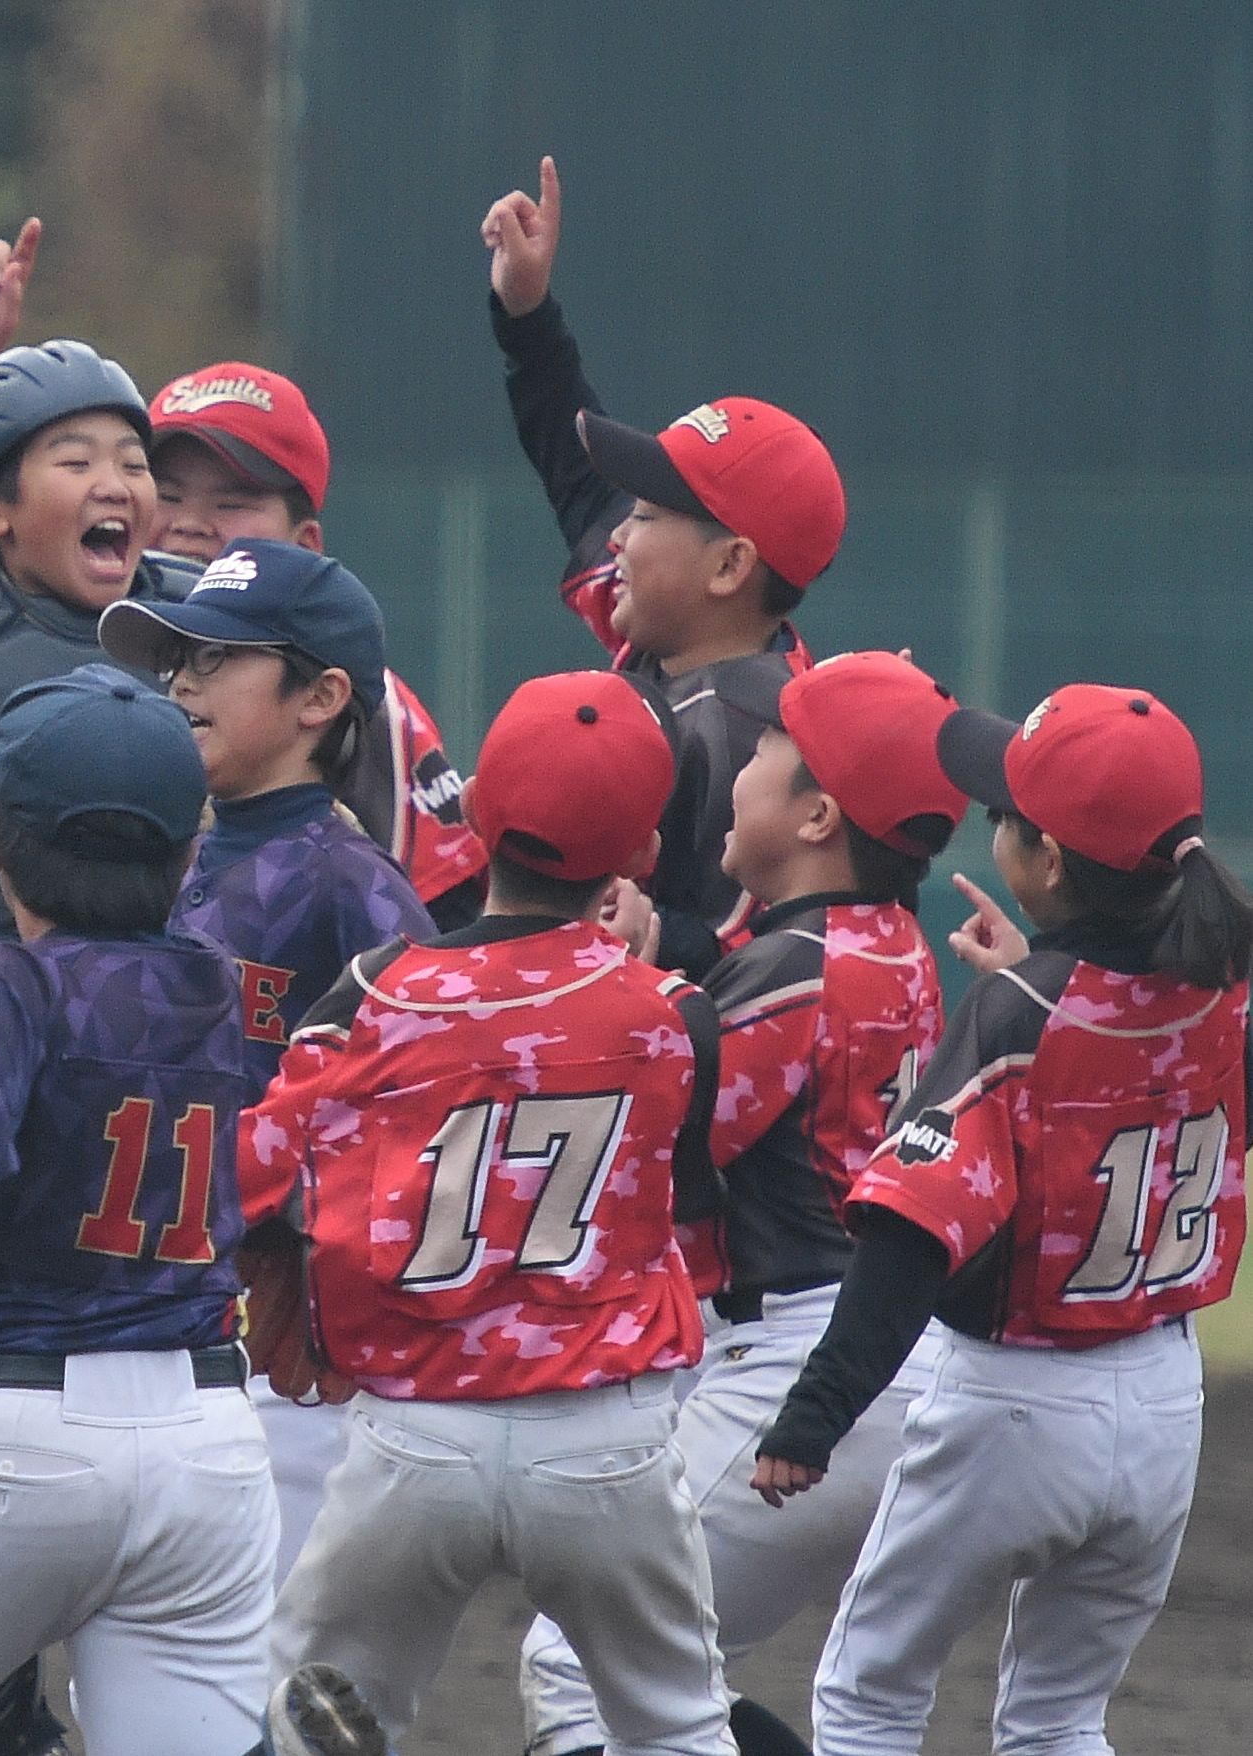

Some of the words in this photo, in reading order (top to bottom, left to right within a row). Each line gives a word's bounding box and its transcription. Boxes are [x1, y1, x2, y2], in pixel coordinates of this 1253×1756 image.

[162, 376, 273, 414] Sumita
[75, 1096, 216, 1264] 11
[396, 1086, 634, 1293] 17
[904, 1121, 959, 1162] IWATE
[1062, 1101, 1229, 1303] 12
